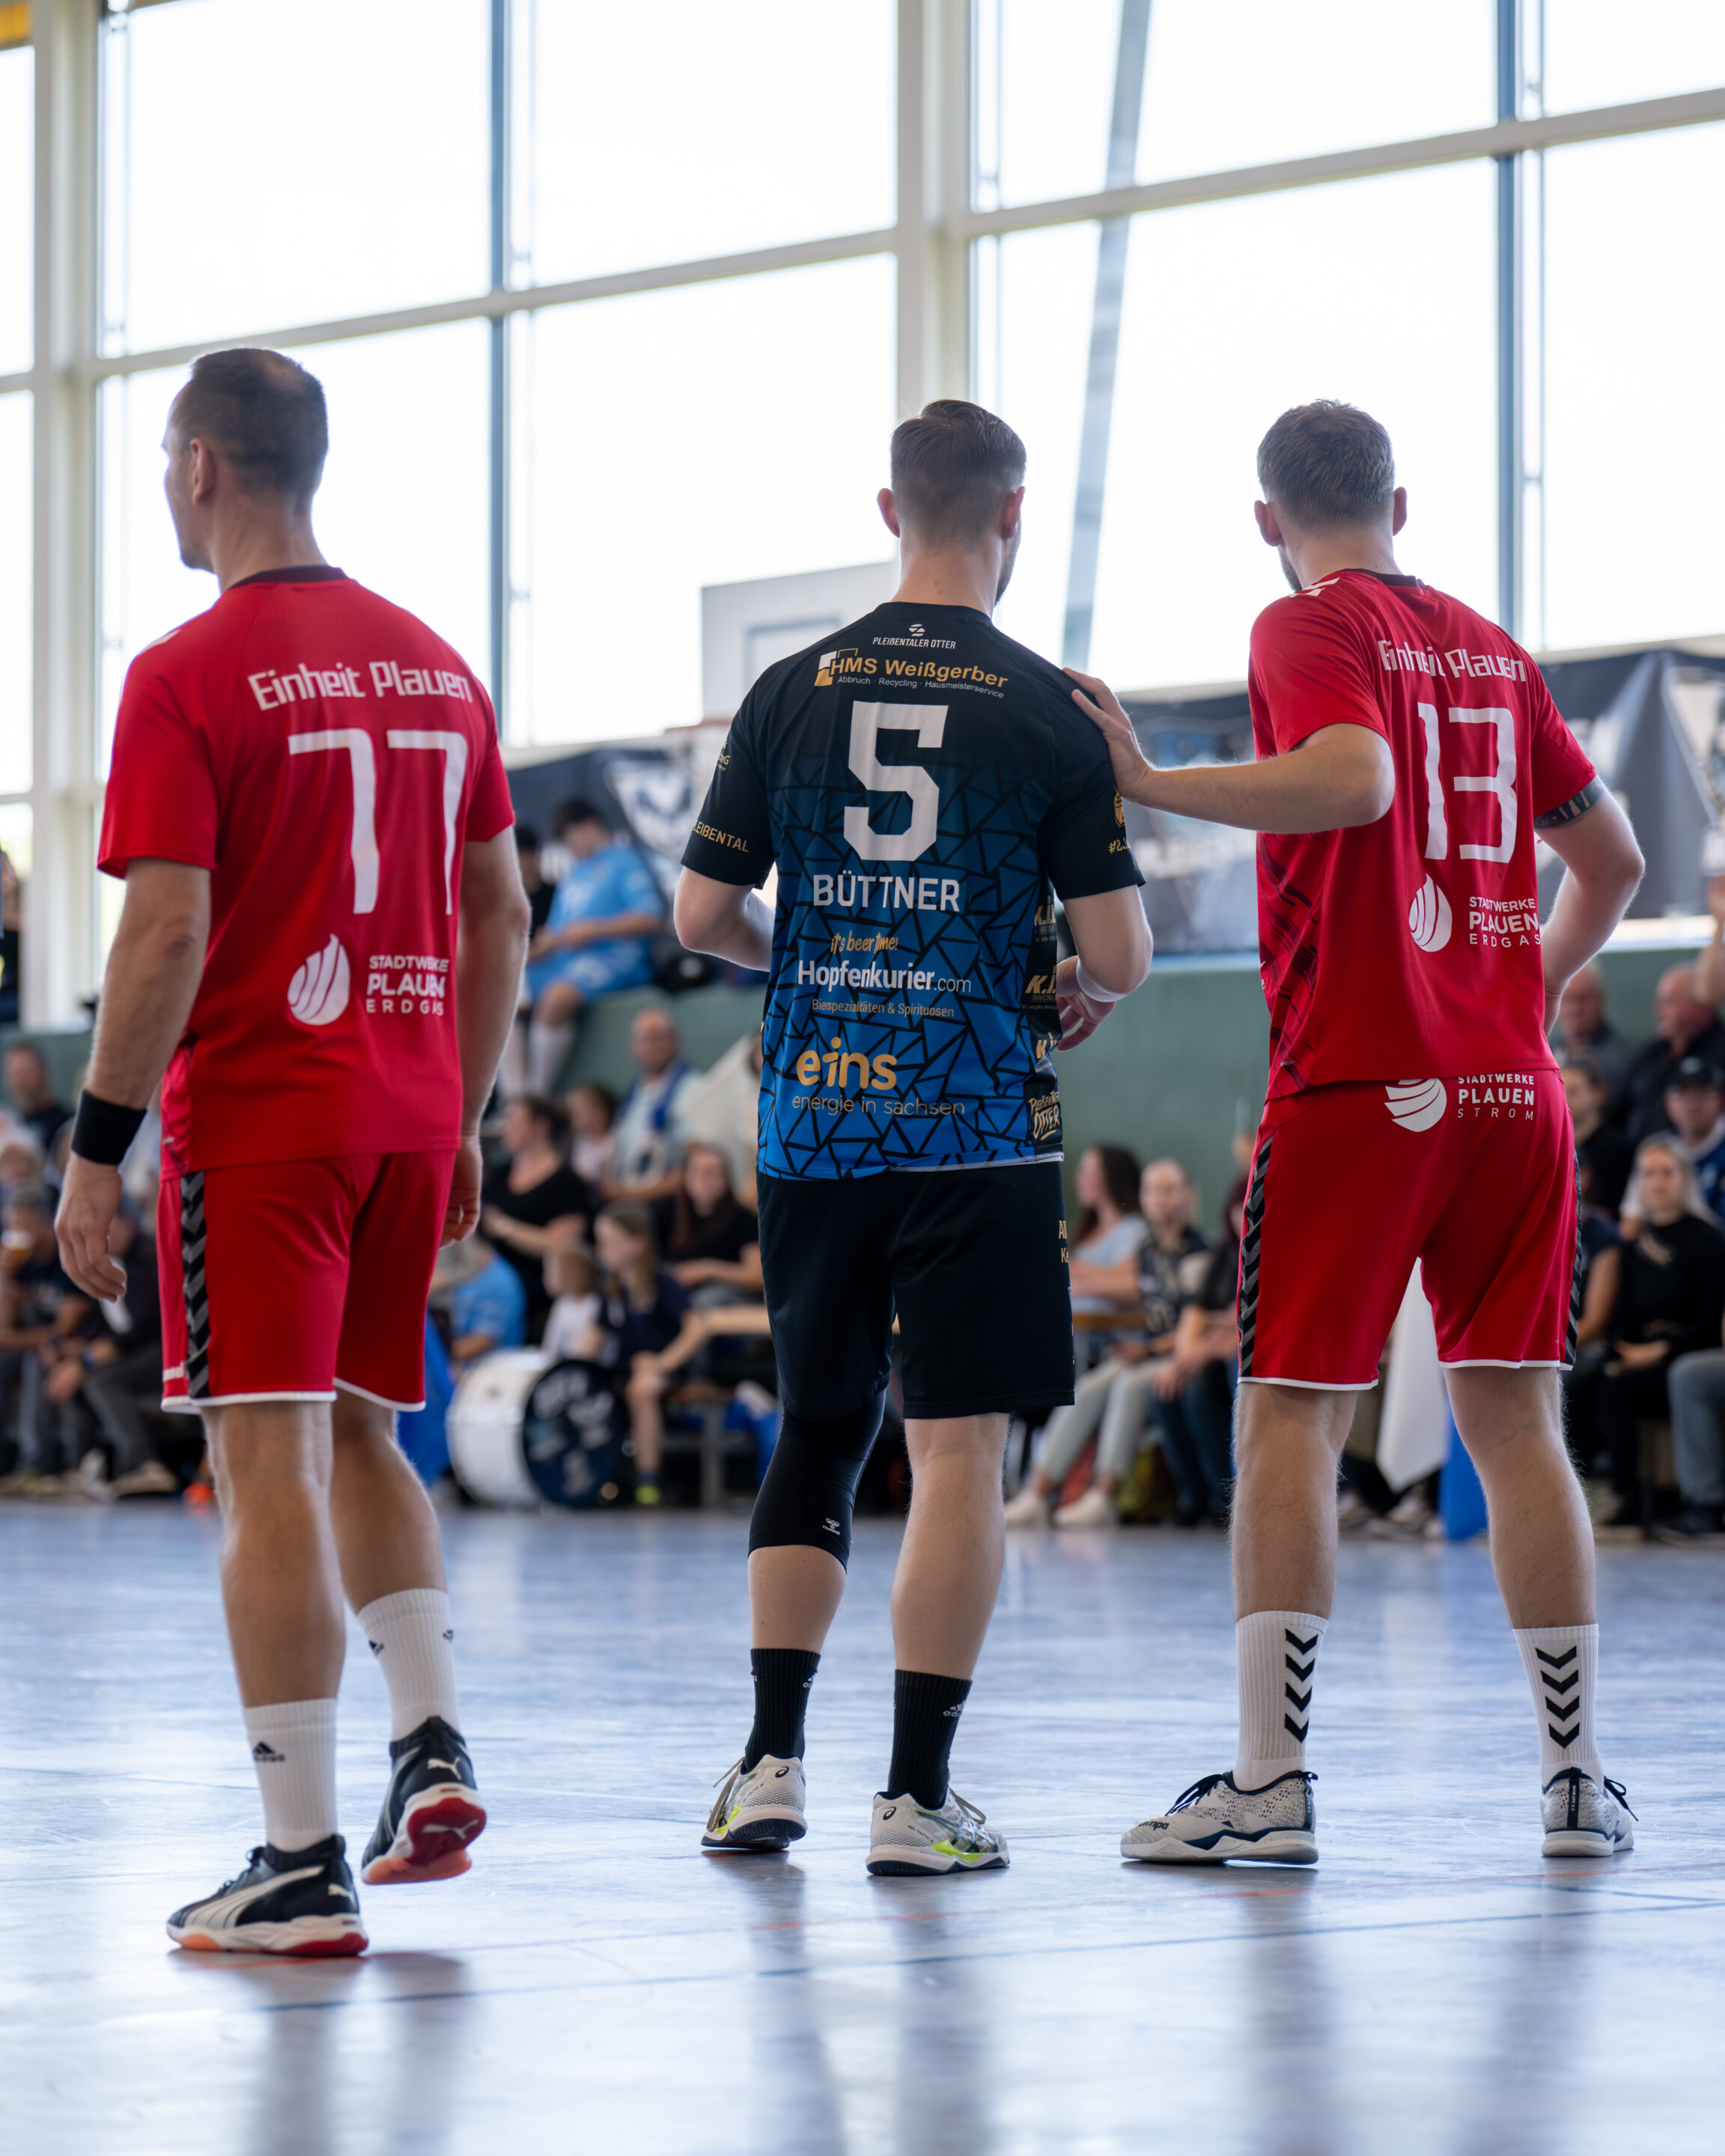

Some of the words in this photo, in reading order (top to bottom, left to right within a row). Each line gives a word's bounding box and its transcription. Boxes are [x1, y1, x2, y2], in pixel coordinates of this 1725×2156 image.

[930, 639, 956, 649] OTTER
[830, 657, 877, 675] HMS
[885, 659, 1008, 688] Weißgerber
[1444, 648, 1527, 682] Plauen
[248, 663, 365, 710] Einheit
[369, 660, 473, 703] Plauen
[837, 676, 871, 686] Abbruch
[878, 677, 918, 689] Recycling
[925, 680, 1005, 698] Hausmeisterservice
[843, 701, 949, 862] 5
[1417, 701, 1518, 863] 13
[287, 728, 467, 915] 77
[813, 870, 961, 912] BÜTTNER
[1469, 896, 1536, 913] STADTWERKE
[1469, 911, 1539, 934] PLAUEN
[846, 930, 874, 952] beer
[1469, 933, 1541, 948] ERDGAS
[797, 960, 972, 993] Hopfenkurier.com
[812, 999, 884, 1014] Bierspezialitäten
[887, 1003, 895, 1014] &
[898, 1003, 955, 1017] Spirituosen
[796, 1036, 897, 1091] eins
[1458, 1073, 1534, 1085] STADTWERKE
[792, 1095, 854, 1115] energie
[862, 1095, 876, 1114] in
[883, 1097, 965, 1115] sachsen
[1458, 1088, 1534, 1106] PLAUEN
[1033, 1104, 1060, 1139] OTTER
[1457, 1107, 1533, 1121] STROM
